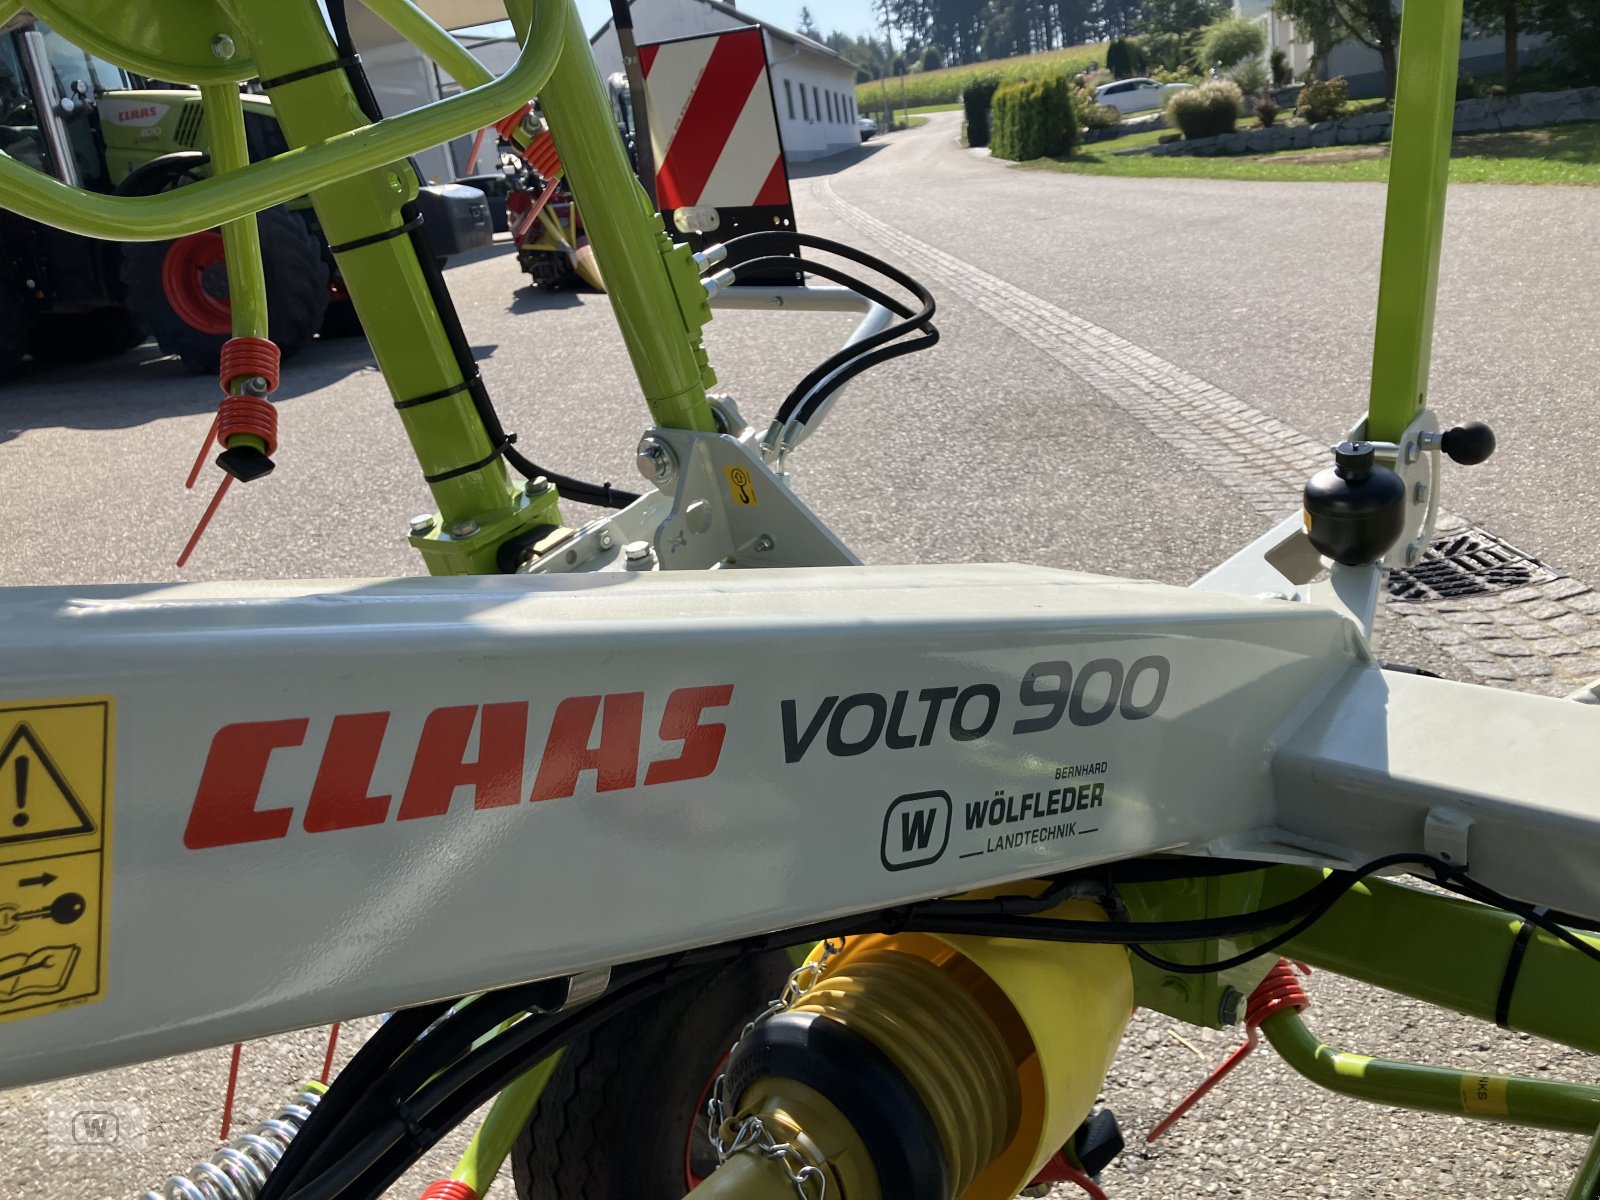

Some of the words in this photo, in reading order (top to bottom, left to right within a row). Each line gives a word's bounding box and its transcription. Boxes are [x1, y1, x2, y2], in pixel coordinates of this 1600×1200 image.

[118, 106, 157, 121] CLAAS
[780, 683, 1001, 764] VOLTO
[1012, 655, 1171, 735] 900
[183, 683, 735, 850] CLAAS
[1054, 761, 1108, 780] BERNHARD
[965, 782, 1105, 831] WÖLFLEDER
[901, 808, 938, 852] W
[986, 821, 1078, 853] LANDTECHNIK
[1478, 1074, 1489, 1100] NKS
